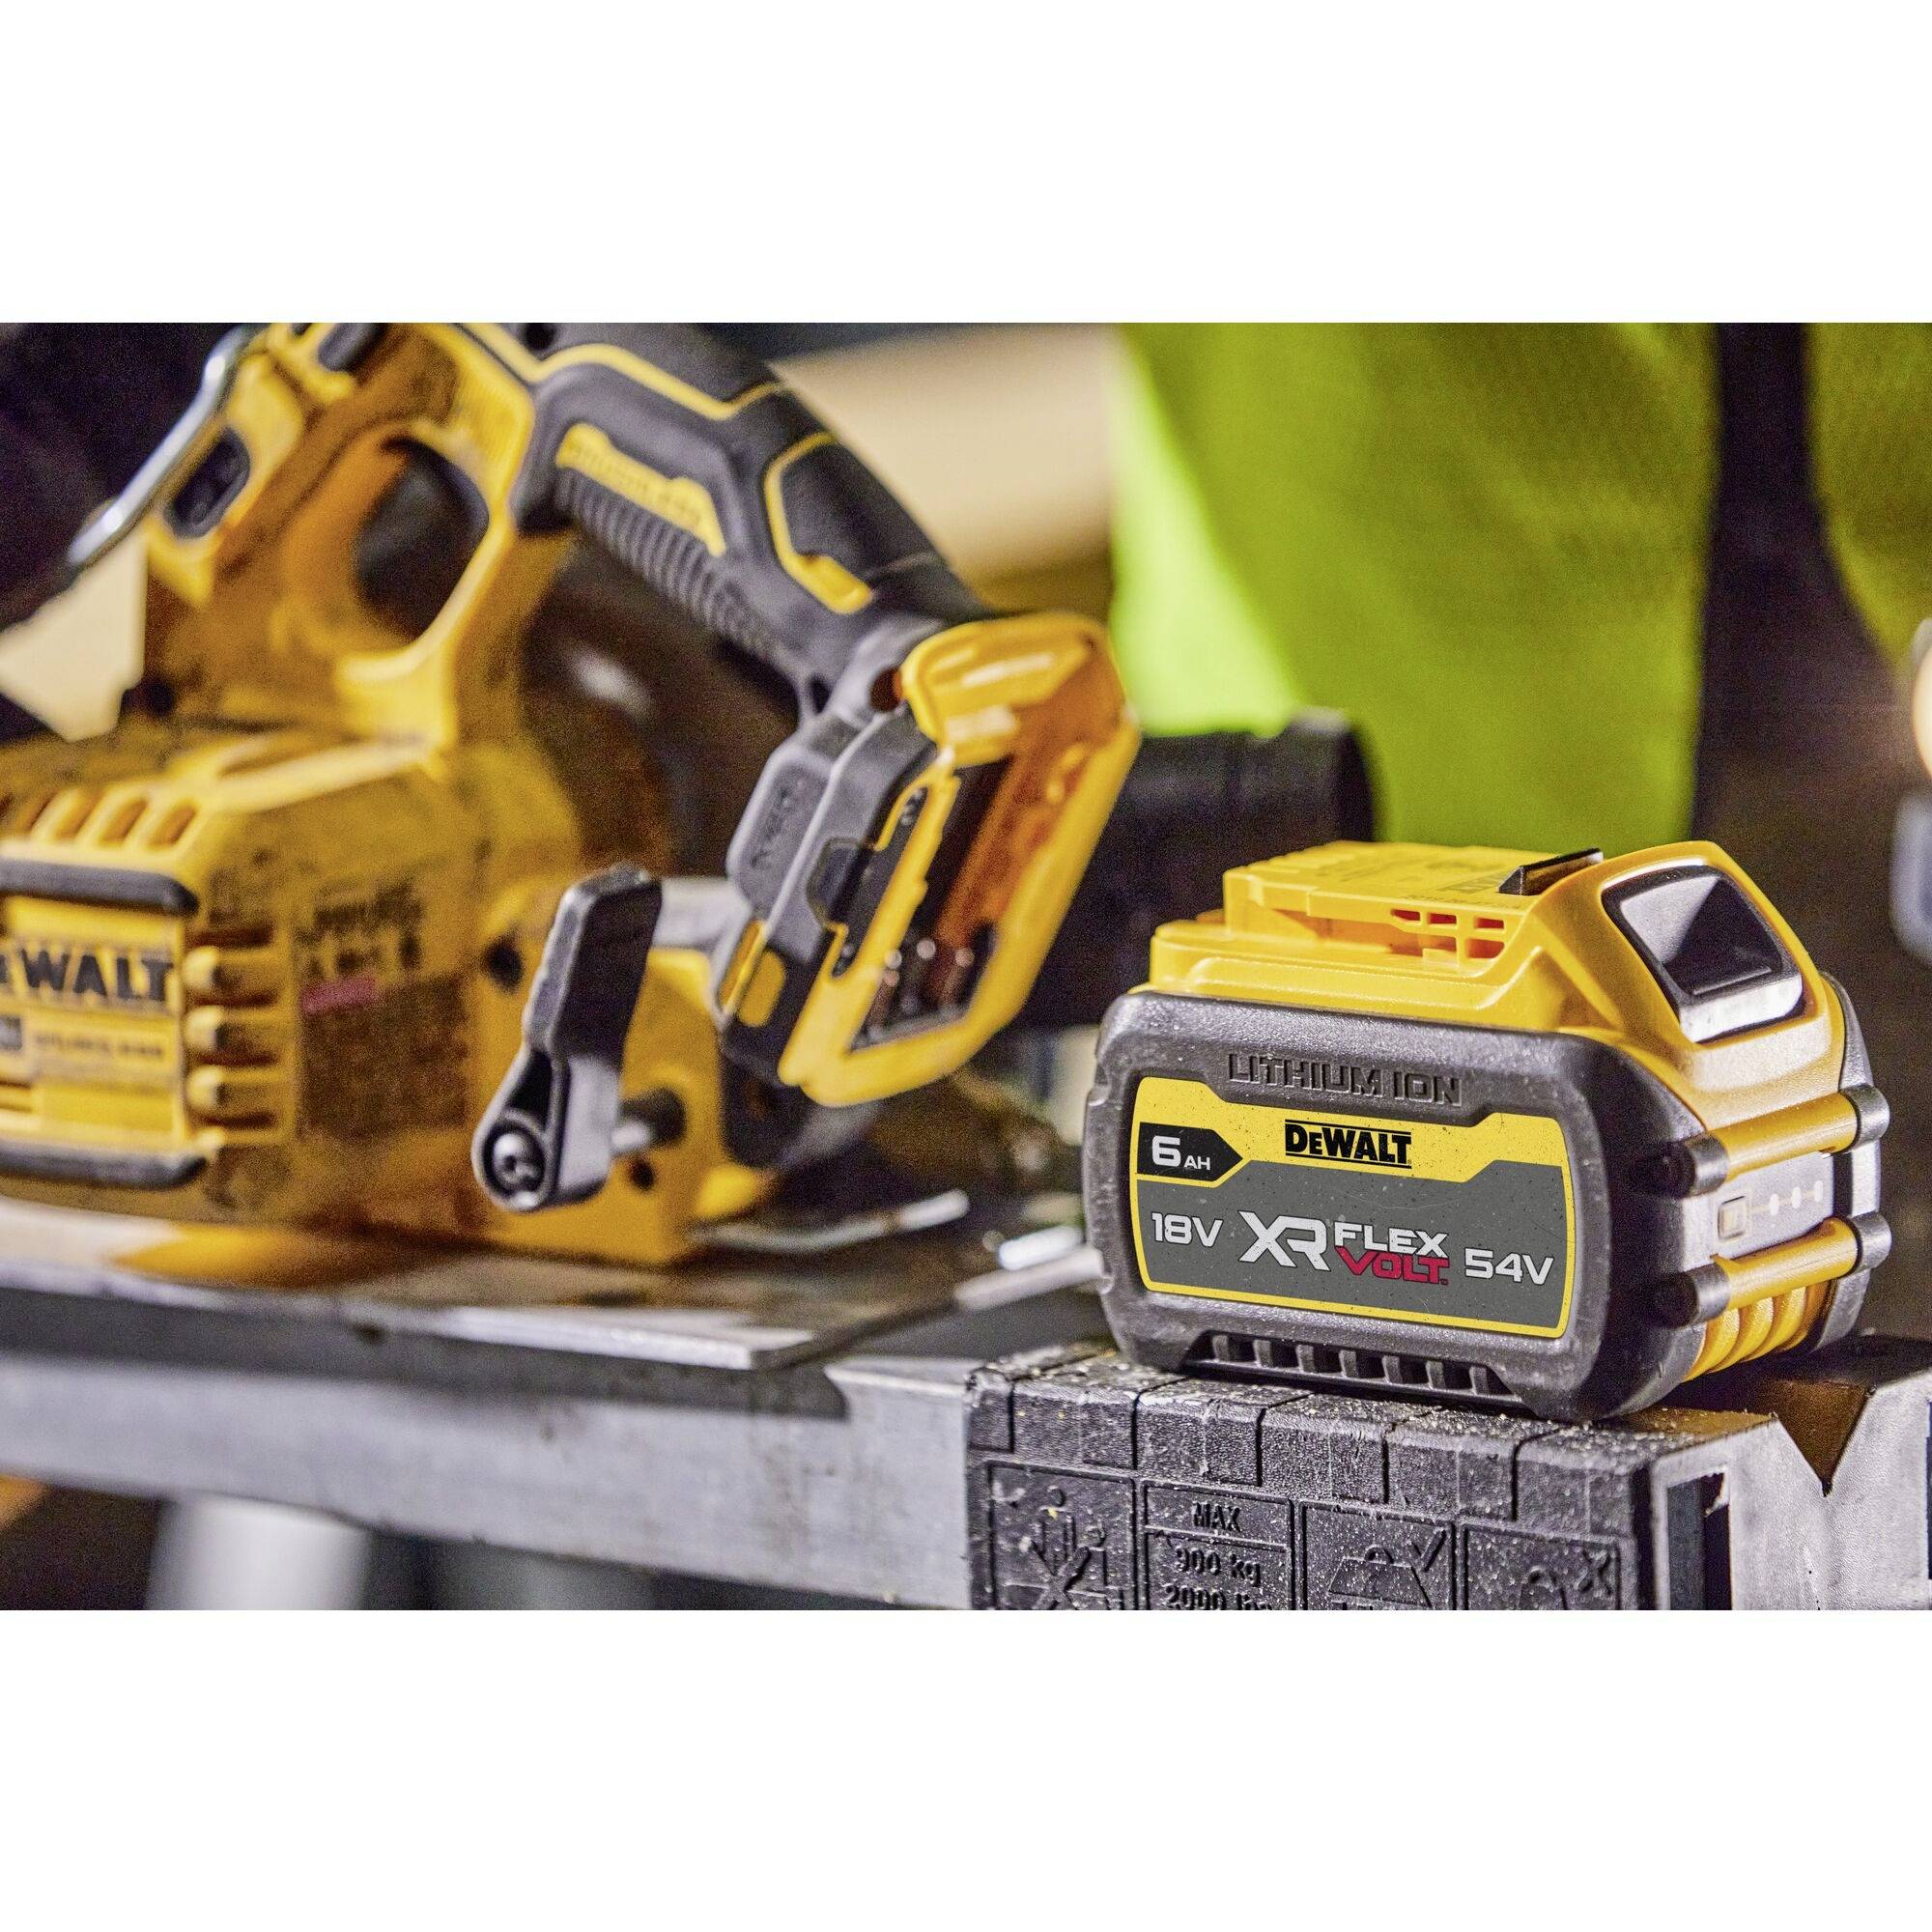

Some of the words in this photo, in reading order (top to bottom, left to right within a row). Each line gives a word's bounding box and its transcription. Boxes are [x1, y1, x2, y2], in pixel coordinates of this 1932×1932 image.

[1228, 1053, 1383, 1097] LITHIUM
[1393, 1070, 1463, 1107] ION
[1151, 1210, 1224, 1248] 18V
[1237, 1209, 1331, 1272] XR
[1334, 1221, 1449, 1259] FLEX
[1463, 1247, 1555, 1287] 54V
[1191, 1501, 1242, 1533] MAX
[1174, 1546, 1222, 1577] 900
[1229, 1551, 1262, 1588] kg
[1161, 1582, 1228, 1610] 2000
